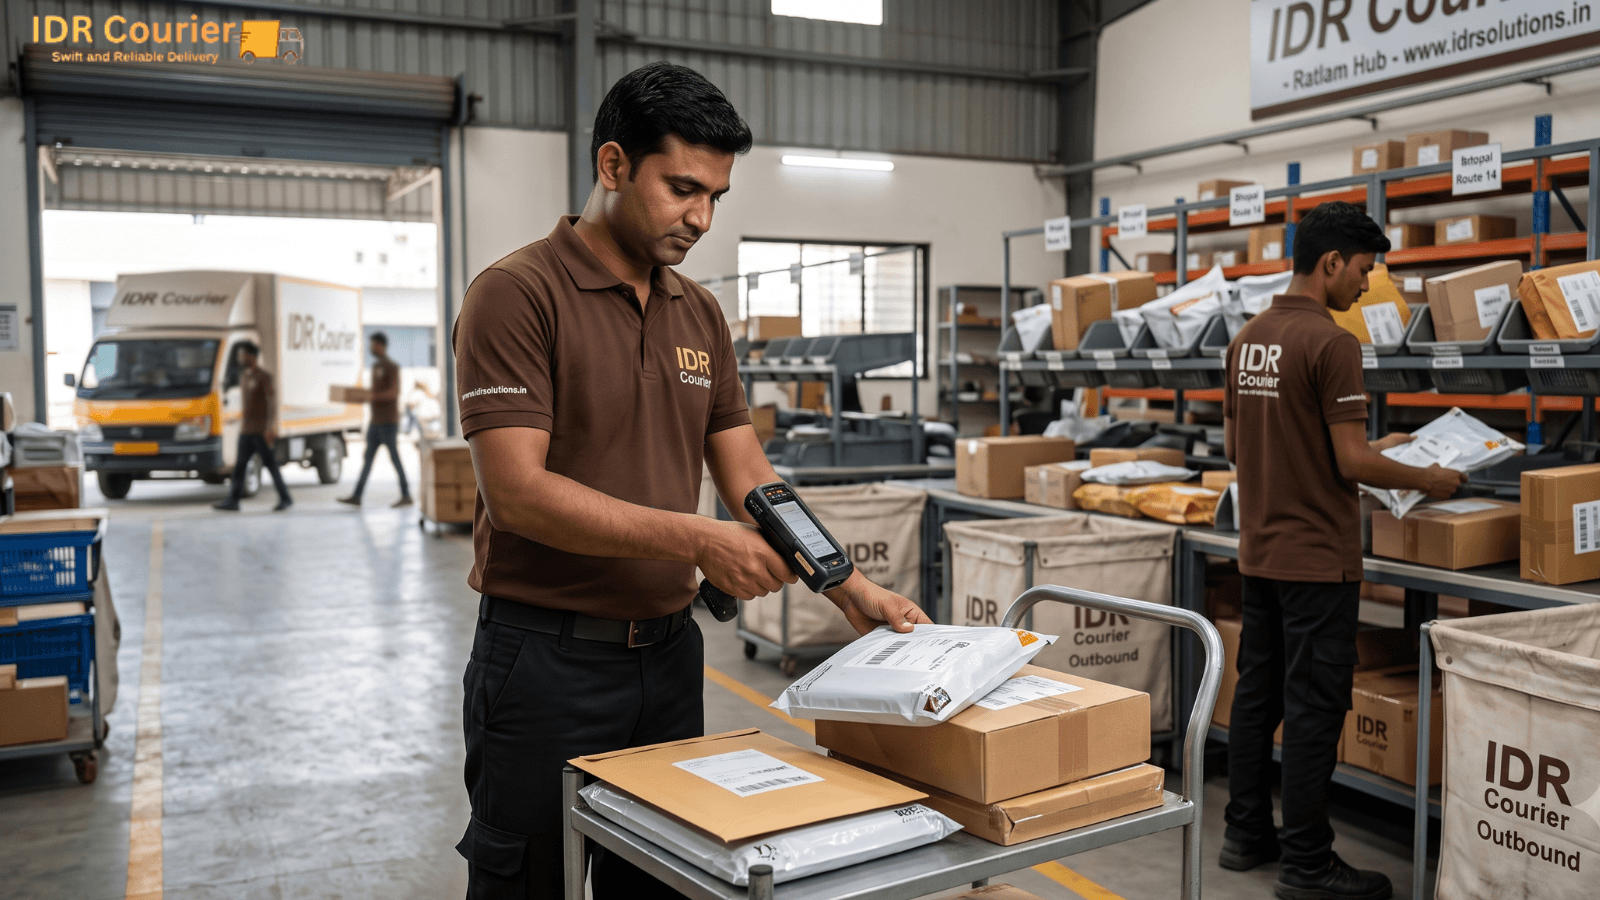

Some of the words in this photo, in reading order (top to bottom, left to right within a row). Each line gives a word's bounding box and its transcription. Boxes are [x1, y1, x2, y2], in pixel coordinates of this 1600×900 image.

[1267, 0, 1352, 63] IDR
[1293, 63, 1349, 91] Ratlam
[1353, 50, 1387, 77] Hub
[1403, 1, 1591, 64] www.idrsolutions.in
[1456, 173, 1483, 185] Route
[1486, 169, 1497, 181] 14
[121, 291, 158, 306] IDR
[161, 290, 229, 306] Courier
[675, 346, 711, 376] IDR
[1238, 343, 1282, 374] IDR
[680, 371, 712, 389] Courier
[1238, 371, 1280, 388] Courier
[846, 541, 889, 563] IDR
[965, 594, 998, 626] IDR
[1074, 629, 1130, 646] Courier
[1069, 647, 1139, 668] Outbound
[1356, 713, 1388, 741] IDR
[1485, 740, 1572, 807] IDR
[1484, 788, 1570, 831] Courier
[1477, 819, 1581, 873] Outbound
